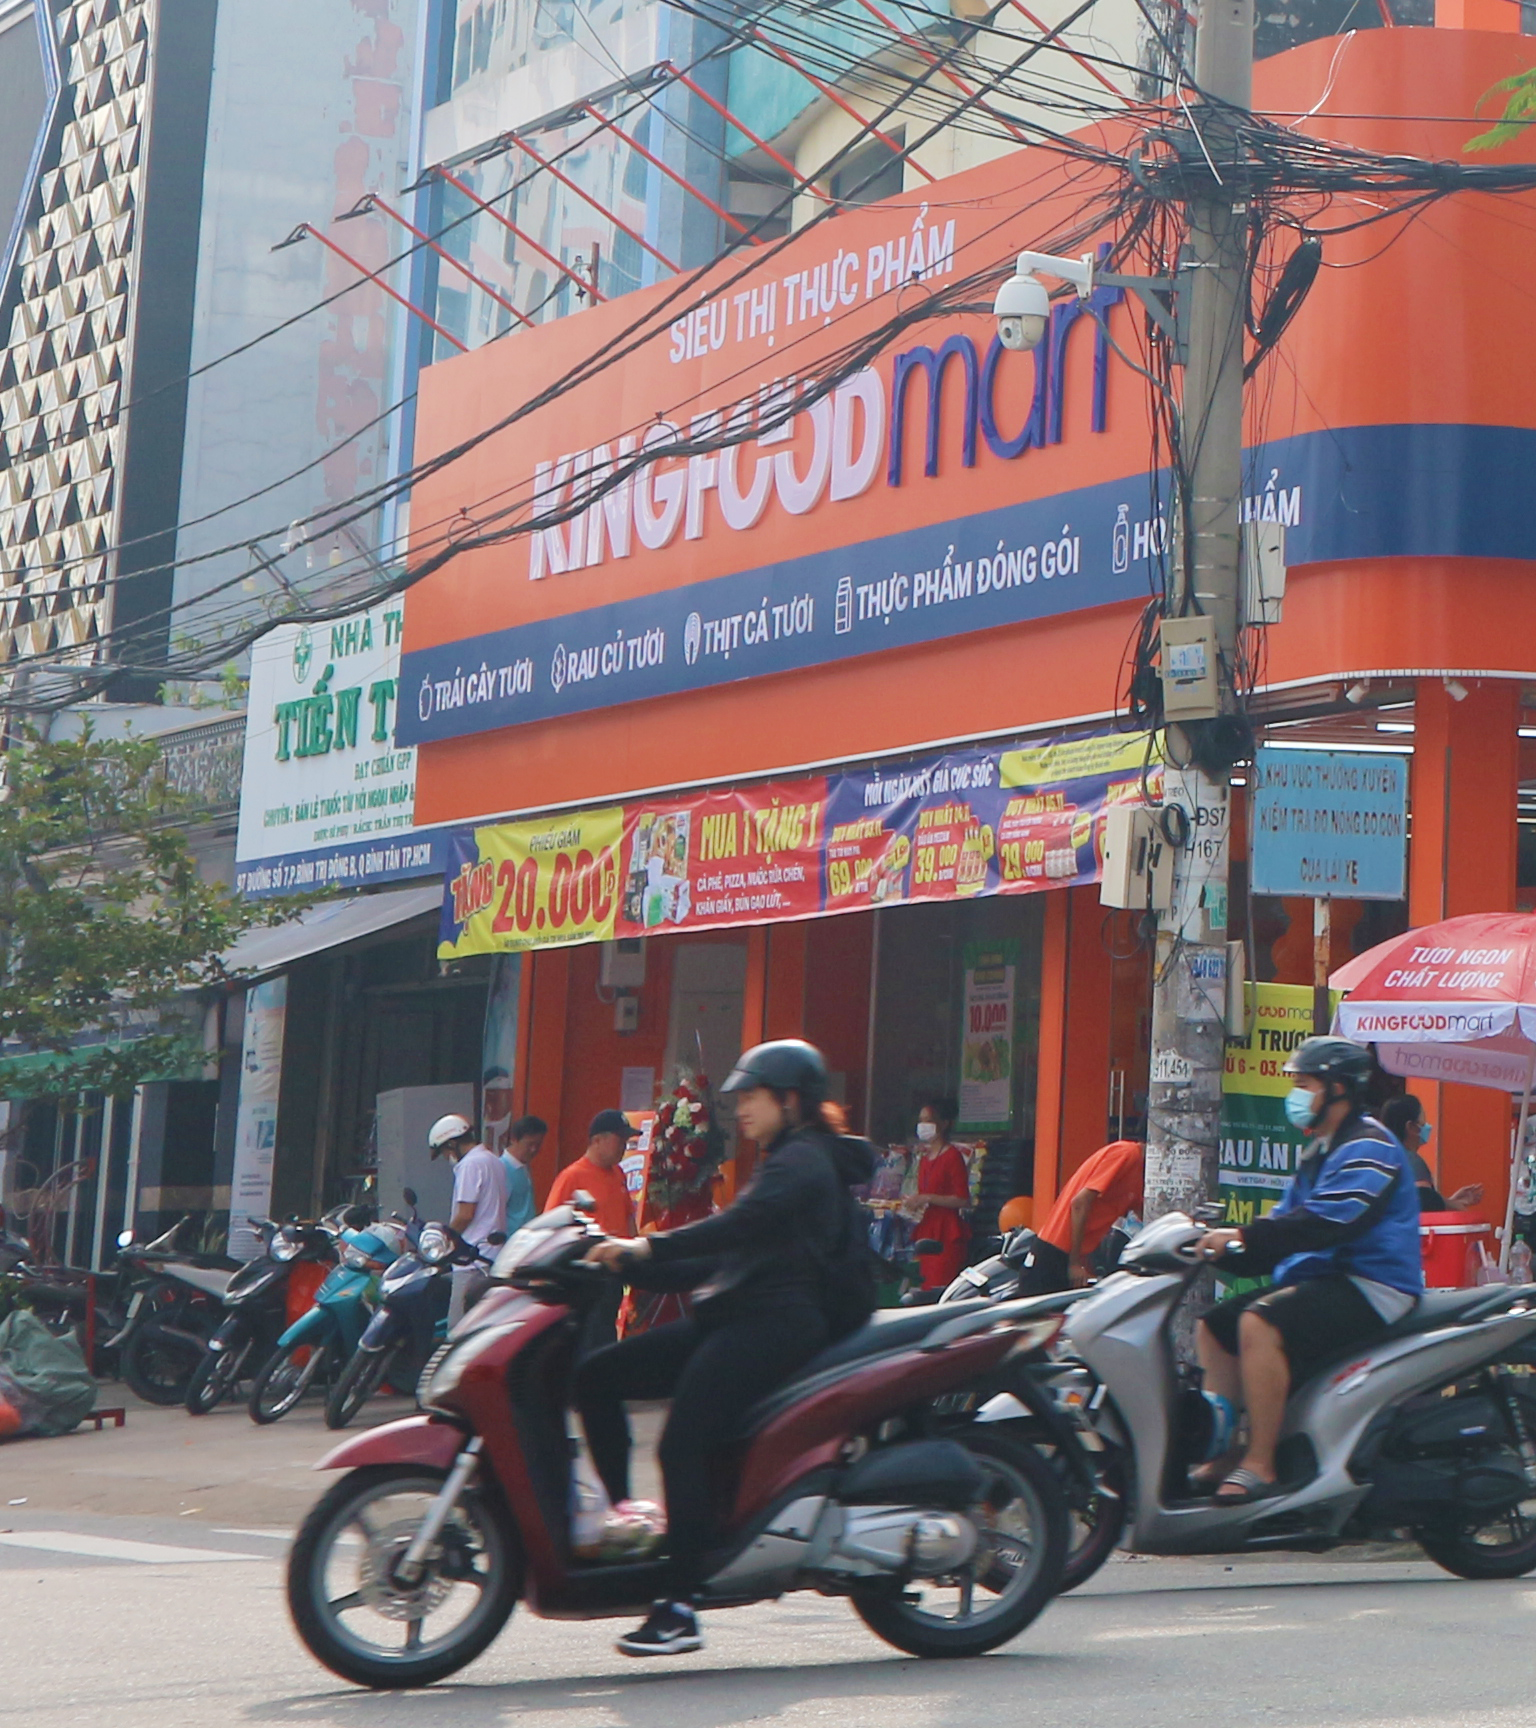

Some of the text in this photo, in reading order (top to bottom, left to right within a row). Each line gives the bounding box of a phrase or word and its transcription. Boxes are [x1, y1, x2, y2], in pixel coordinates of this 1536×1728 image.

[669, 201, 956, 364] SIÊU THỊ THỰC PHẨM
[1132, 467, 1301, 561] HÓ HẨM
[856, 524, 1081, 626] THỰC PHẨM ĐÓNG GÓI
[331, 607, 373, 660] NHÀ
[566, 626, 665, 684] RAU CỦ TƯƠI
[703, 593, 814, 660] THỊT CÁ TƯƠI
[274, 663, 400, 761] TIẾN T
[434, 656, 533, 711] TRÁI CÂY TƯƠI
[700, 797, 820, 865] MUA 1 TẶNG 1
[451, 857, 494, 937] TẶNG
[1384, 965, 1505, 990] CHẤT LƯỢNG
[1409, 946, 1514, 965] TƯƠI NGON
[1238, 1059, 1246, 1073] 6
[1258, 1136, 1288, 1170] ĂN
